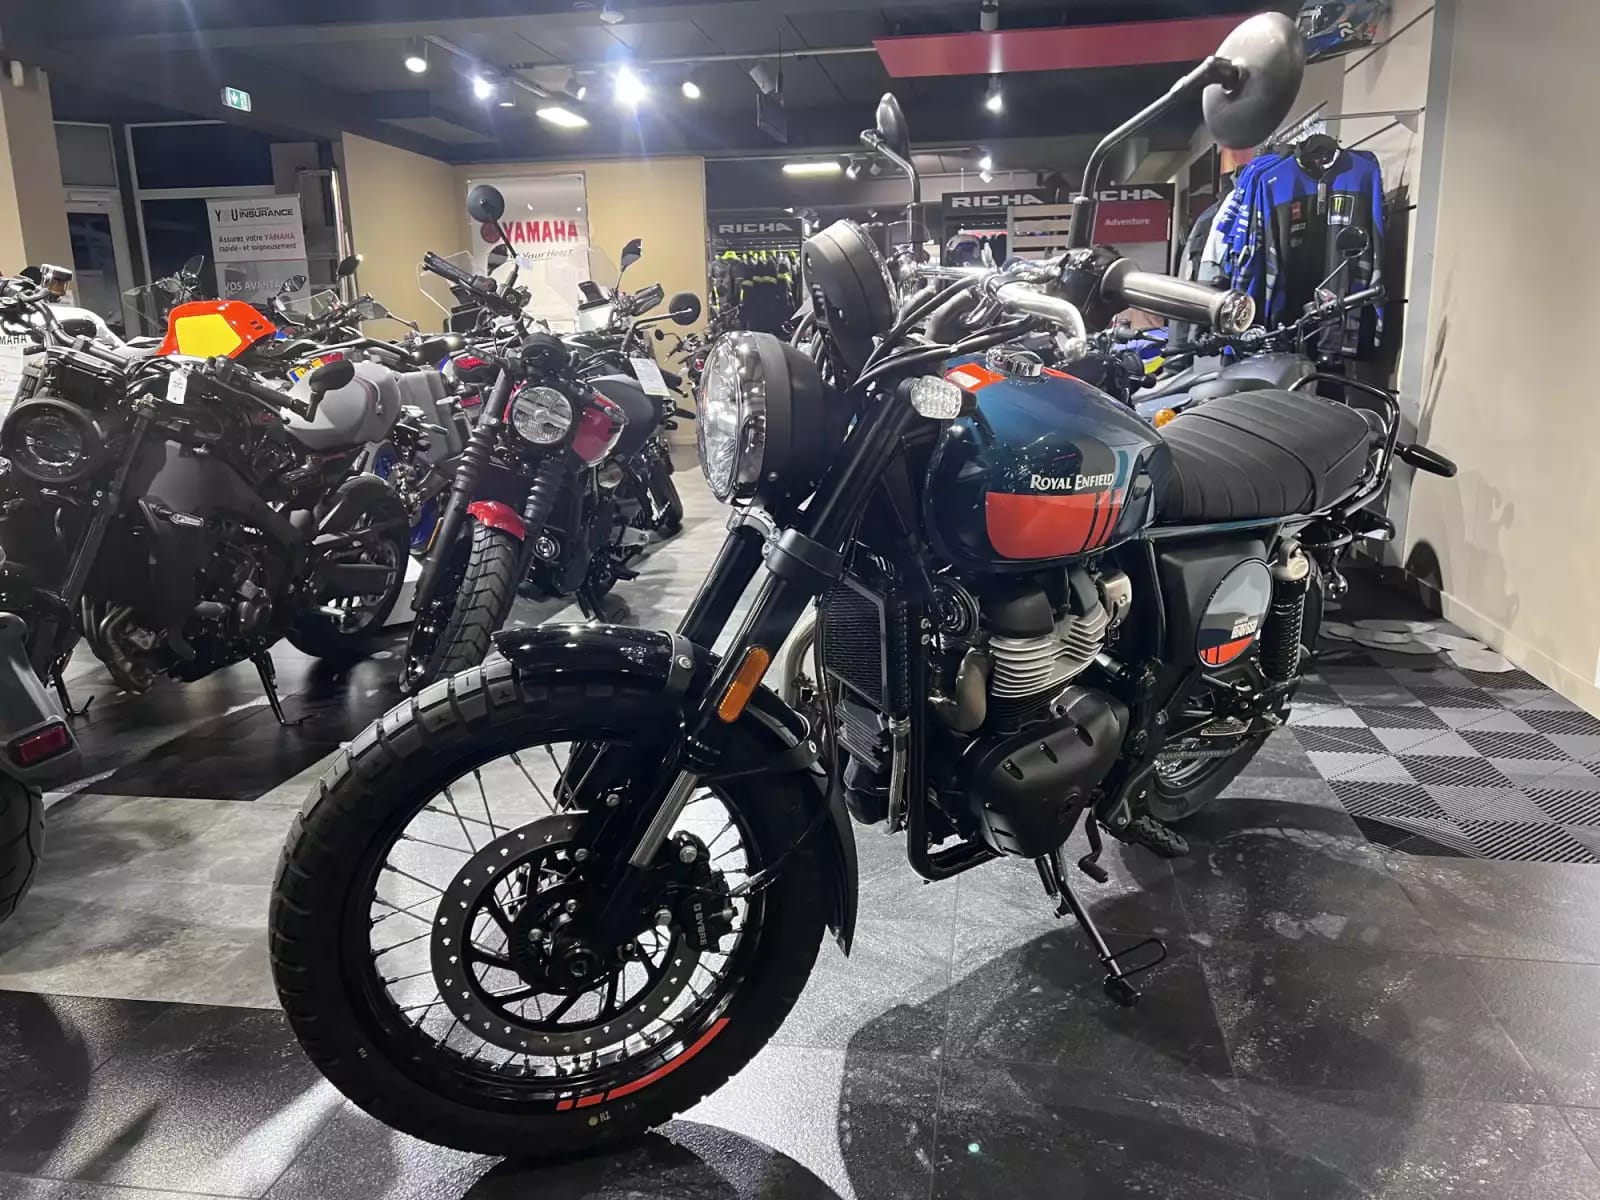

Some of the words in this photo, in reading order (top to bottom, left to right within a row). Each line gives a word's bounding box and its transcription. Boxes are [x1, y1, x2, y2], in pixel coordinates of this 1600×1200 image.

[952, 194, 1044, 208] RICHA
[239, 208, 294, 218] INSURANCE
[1104, 218, 1151, 226] Adventure
[502, 220, 578, 243] YAMAHA
[719, 223, 792, 233] RICHA
[219, 235, 244, 243] Assurez
[245, 234, 263, 242] votre
[264, 232, 295, 241] YAMAHA
[1030, 474, 1072, 490] ROYAL
[1074, 473, 1114, 490] ENFIELD
